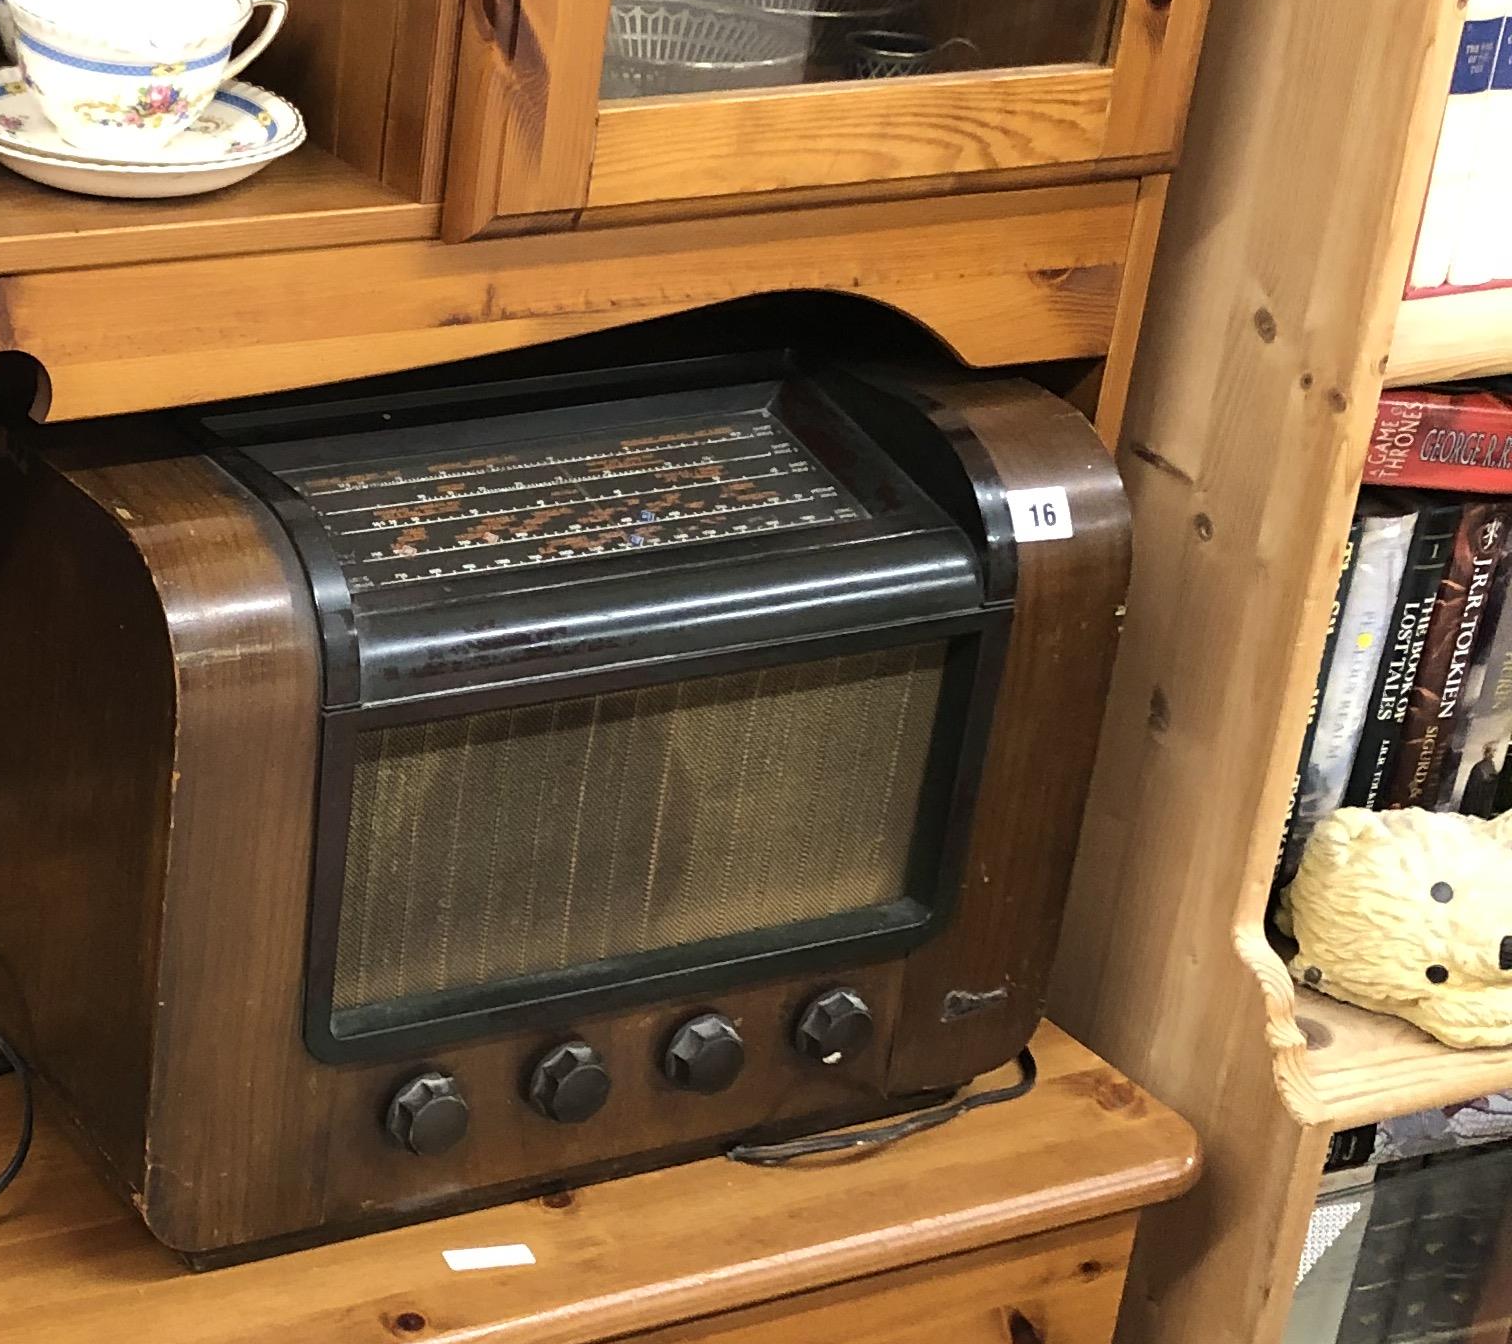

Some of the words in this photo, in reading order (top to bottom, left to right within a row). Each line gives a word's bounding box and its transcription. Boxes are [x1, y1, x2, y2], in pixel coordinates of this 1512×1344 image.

[1368, 420, 1400, 465] GAME
[1378, 401, 1424, 478] THRONES
[1419, 428, 1485, 466] GEORGE
[1028, 502, 1057, 527] 16
[1463, 555, 1493, 618] J.R.R.
[1393, 602, 1420, 654] LOST
[1415, 592, 1437, 638] THE
[1377, 656, 1407, 721] TALES
[1400, 639, 1425, 696] BOOK
[1438, 614, 1479, 719] TOLKIEN
[1394, 696, 1409, 724] OF
[1415, 725, 1439, 784] SIGURD
